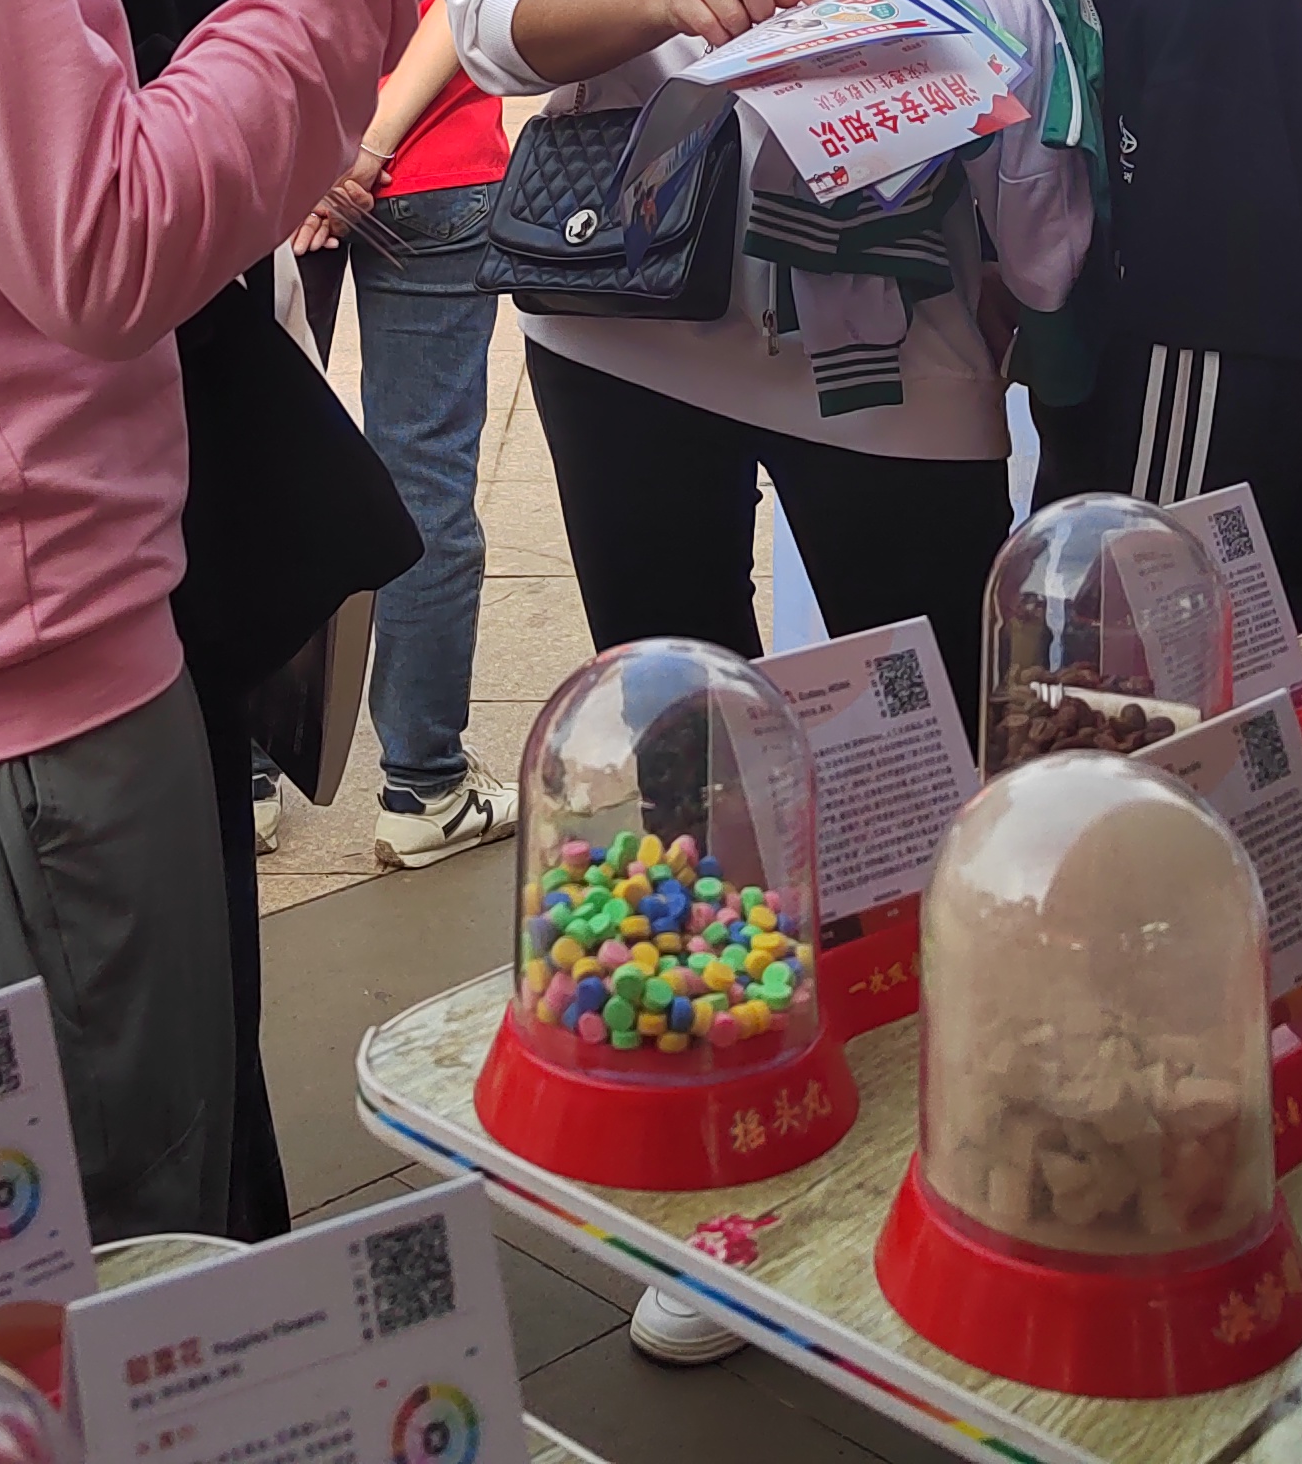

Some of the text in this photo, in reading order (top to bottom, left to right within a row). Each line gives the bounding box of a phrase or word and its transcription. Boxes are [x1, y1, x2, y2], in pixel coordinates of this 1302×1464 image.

[808, 73, 981, 158] 消防安全知识
[731, 1080, 834, 1153] 摇头丸
